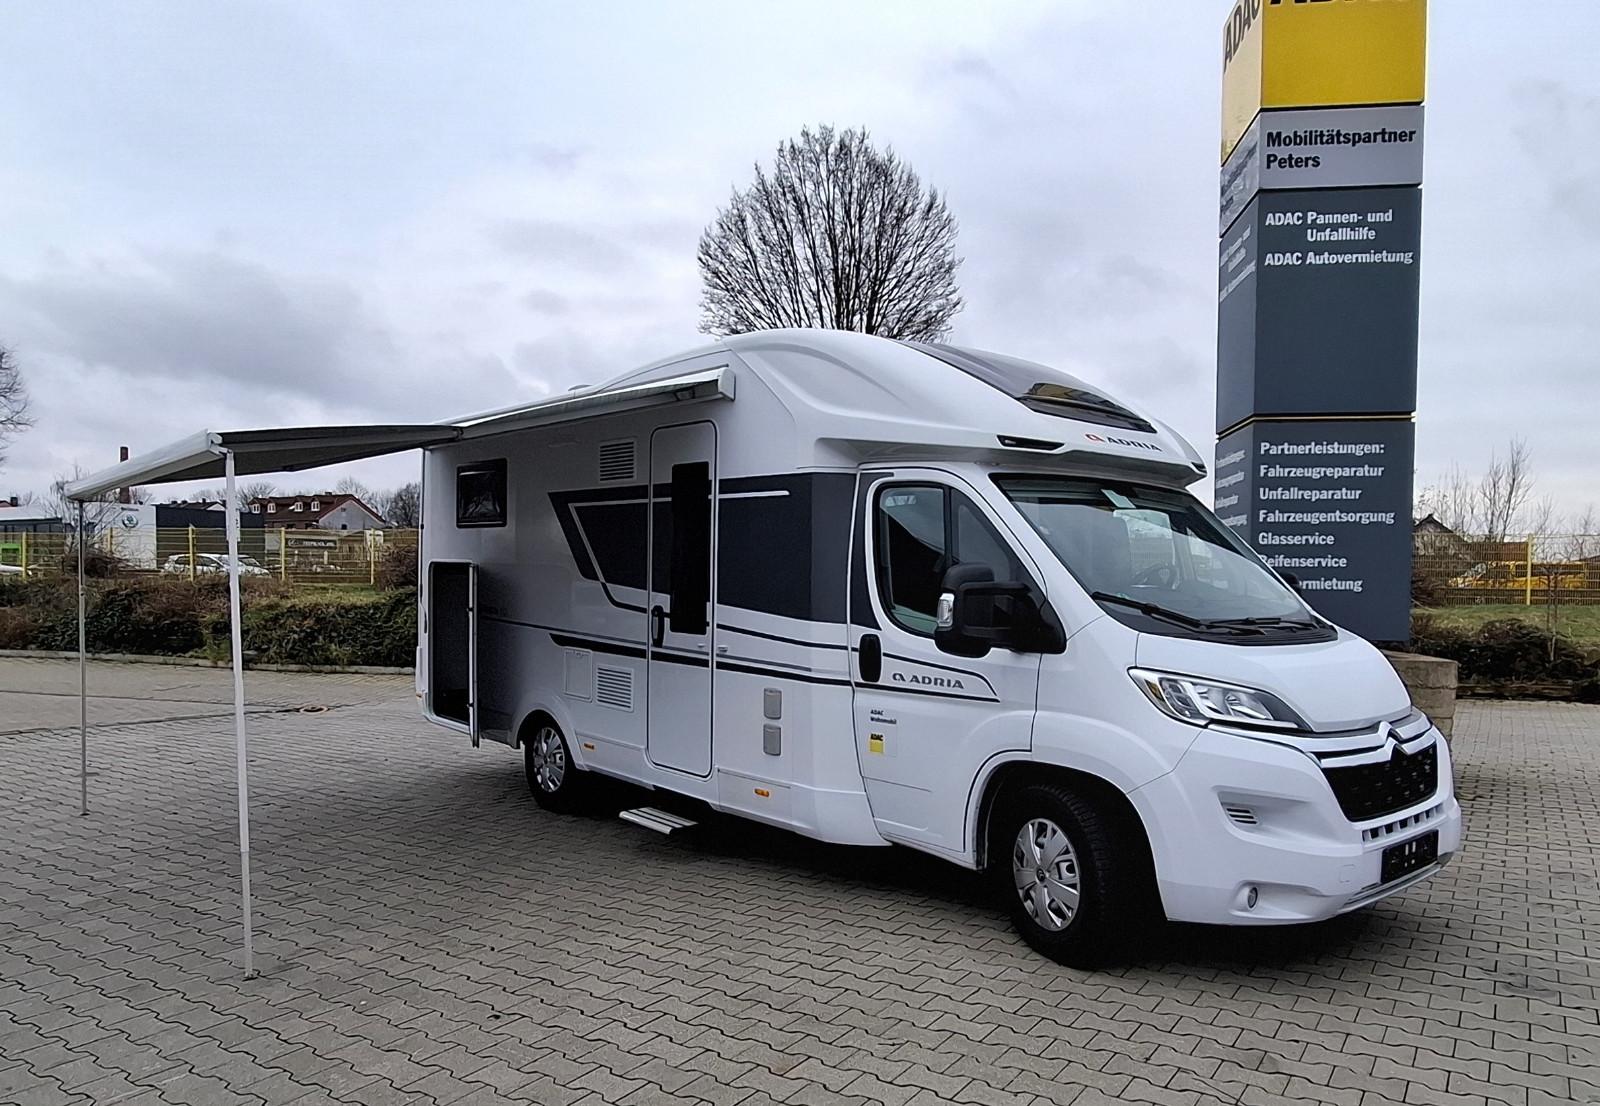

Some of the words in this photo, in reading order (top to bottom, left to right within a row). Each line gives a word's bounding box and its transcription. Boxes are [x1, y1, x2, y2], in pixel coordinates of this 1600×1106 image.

[1266, 127, 1416, 149] Mobilitätspartner
[1266, 153, 1321, 169] Peters
[1265, 211, 1303, 226] ADAC
[1307, 210, 1363, 225] Pannen-
[1367, 209, 1393, 223] und
[1306, 227, 1376, 242] Unfallhilfe
[1264, 251, 1302, 266] ADAC
[1306, 249, 1414, 265] Autovermietung
[1107, 437, 1162, 451] ADRIA
[1260, 442, 1385, 456] Partnerleistungen:
[1260, 465, 1385, 479] Fahrzeugreparatur
[1259, 487, 1362, 501] Unfallreparatur
[1259, 509, 1396, 525] Fahrzeugentsorgung
[1258, 532, 1335, 546] Glasservice
[910, 675, 964, 689] ADRIA
